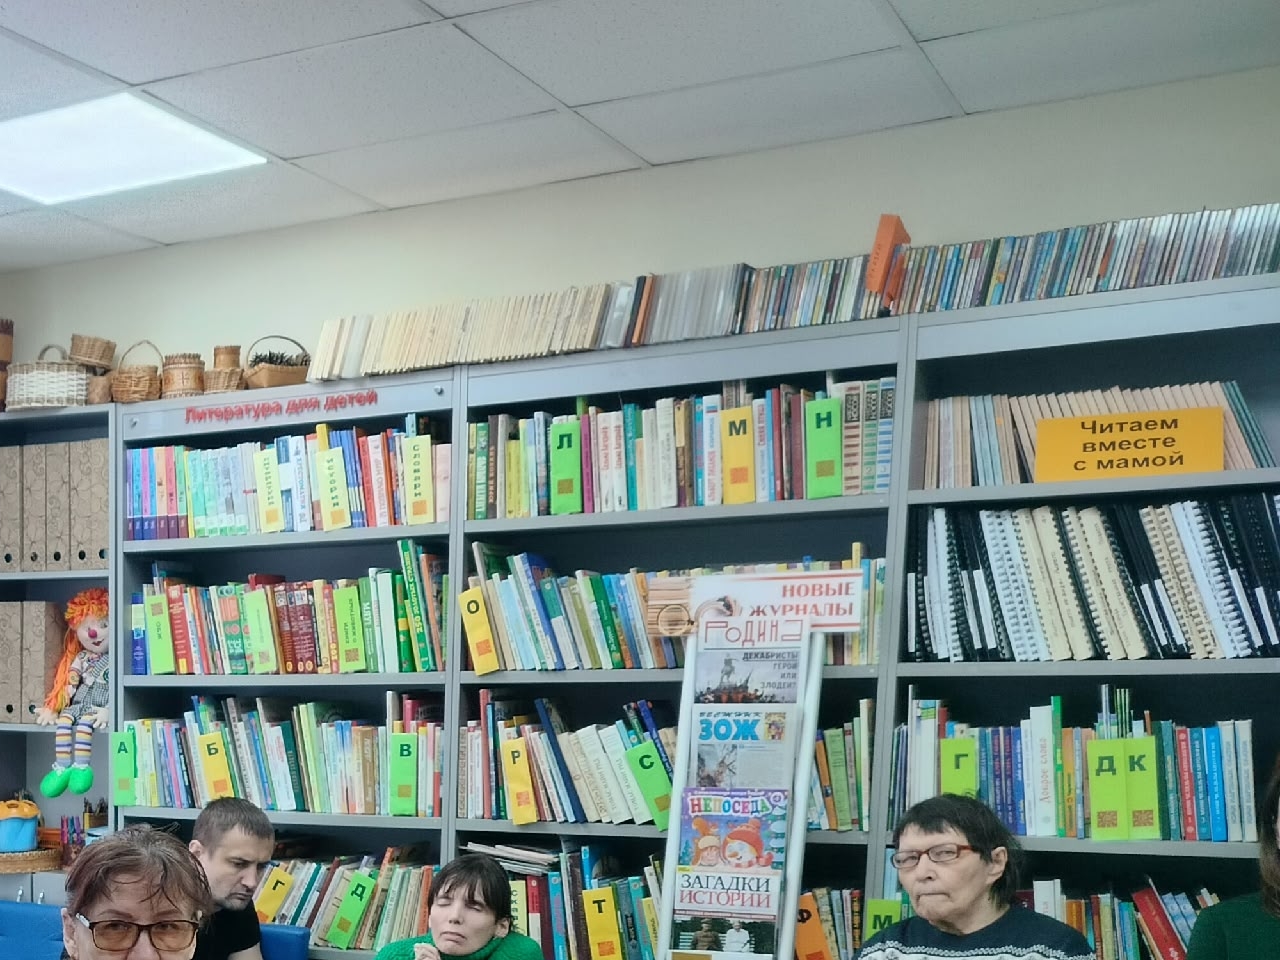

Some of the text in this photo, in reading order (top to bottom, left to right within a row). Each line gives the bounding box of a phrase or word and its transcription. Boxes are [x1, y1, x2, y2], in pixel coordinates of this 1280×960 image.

[185, 390, 378, 425] Литература для детей
[728, 419, 747, 437] М
[815, 411, 832, 429] Н
[1081, 418, 1179, 435] Читаем
[556, 432, 573, 450] Л
[1082, 436, 1177, 453] вместе
[1073, 451, 1184, 471] с мамой
[782, 582, 856, 598] НОВЫЕ
[467, 599, 480, 614] О
[748, 602, 853, 617] ЖУРНАЛЫ
[742, 652, 799, 661] ДЕКАБРИСТЫ
[780, 672, 797, 680] ИЛИ
[698, 718, 761, 741] ЗОЖ
[117, 741, 128, 754] А
[206, 742, 219, 757] Б
[399, 743, 412, 757] В
[510, 750, 521, 765] Р
[638, 754, 655, 770] С
[953, 753, 969, 770] Г
[1095, 755, 1117, 777] Д
[1128, 754, 1147, 773] К
[690, 797, 770, 816] НЕПОСЕДА
[681, 874, 770, 892] ЗАГАДКИ
[351, 883, 367, 902] Д
[680, 889, 771, 908] ИСТОРИИ
[592, 899, 606, 914] Т
[872, 914, 893, 930] М
